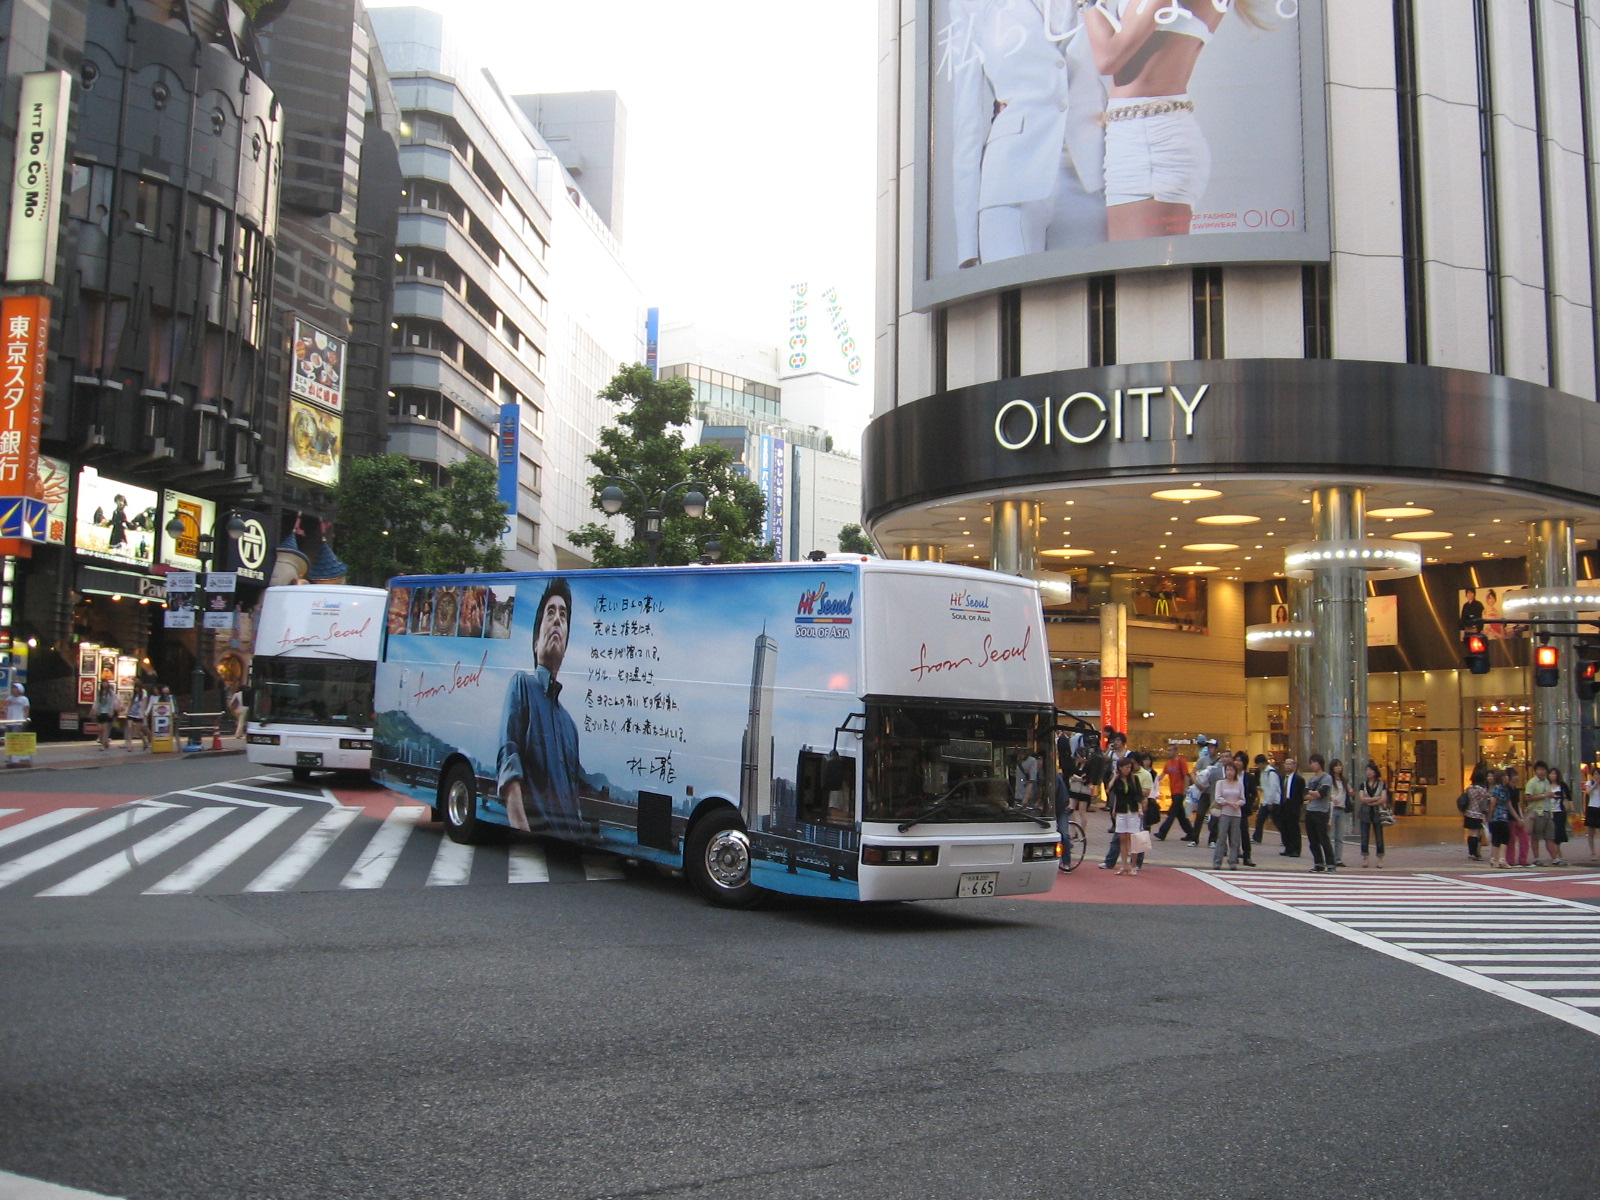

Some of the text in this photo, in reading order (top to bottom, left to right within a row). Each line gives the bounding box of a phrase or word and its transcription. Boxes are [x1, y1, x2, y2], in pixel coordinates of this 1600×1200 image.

[32, 102, 43, 128] NTT
[1192, 221, 1238, 230] SWIMWEAR
[788, 281, 808, 369] PARCO
[821, 286, 862, 376] PARCO
[0, 314, 31, 482] 東京スター銀行
[25, 317, 48, 481] TOKYO STAR BANK
[816, 591, 854, 616] Seoul
[965, 594, 989, 609] Seoul
[794, 624, 850, 639] SOUL OF ASIA
[951, 612, 968, 621] SOUL
[977, 614, 991, 623] ASIA
[277, 617, 371, 649] from Seoul
[910, 625, 1031, 683] from Seoul
[413, 649, 488, 705] from Seoul
[154, 717, 169, 733] P
